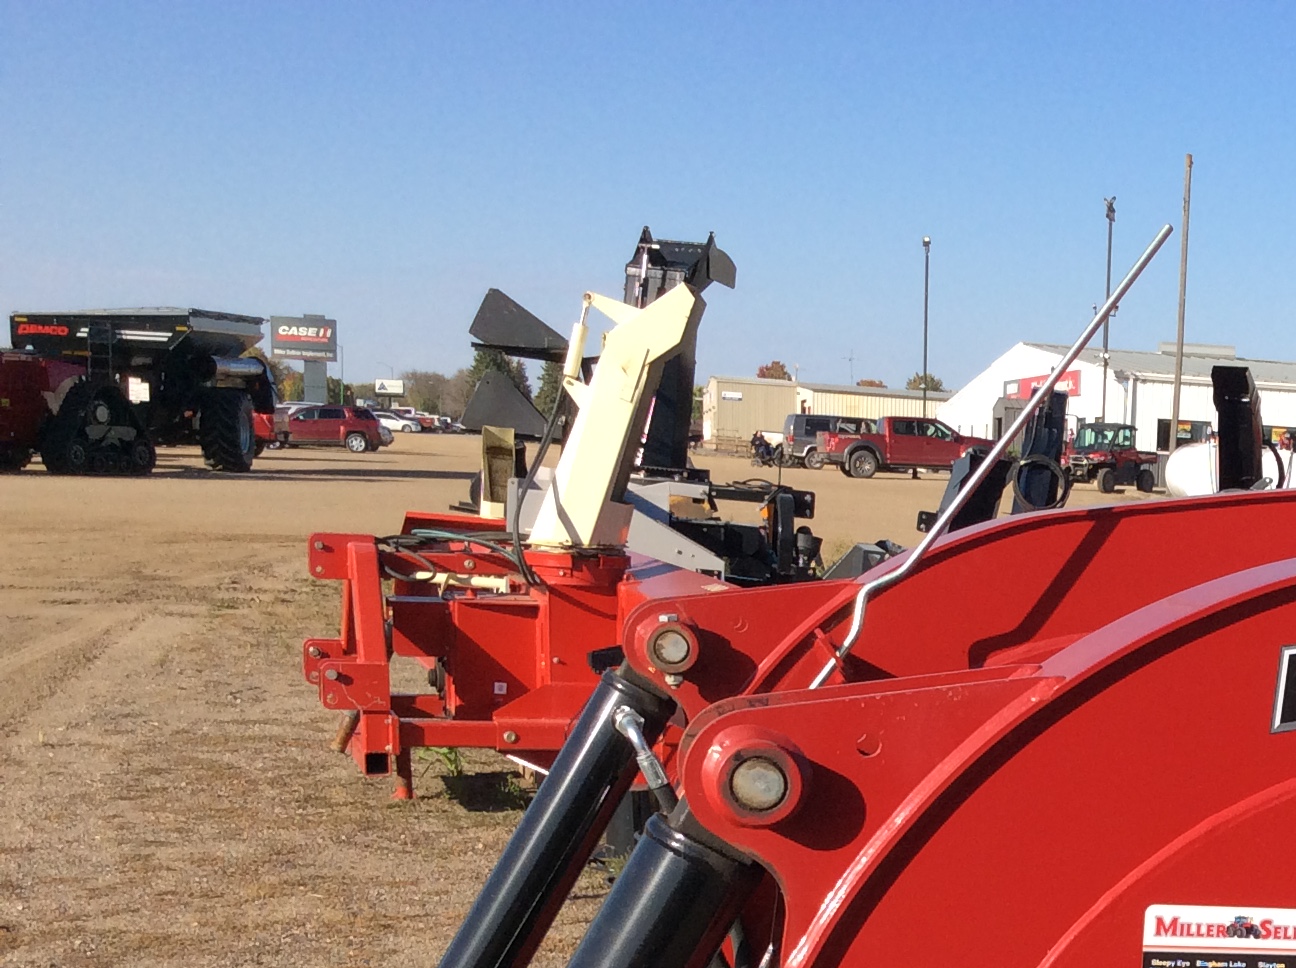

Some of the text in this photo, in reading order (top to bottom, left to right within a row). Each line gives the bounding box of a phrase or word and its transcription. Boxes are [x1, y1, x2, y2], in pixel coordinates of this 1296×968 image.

[17, 323, 69, 336] DEMCO
[278, 325, 318, 336] CASE
[1154, 915, 1229, 938] MILLER
